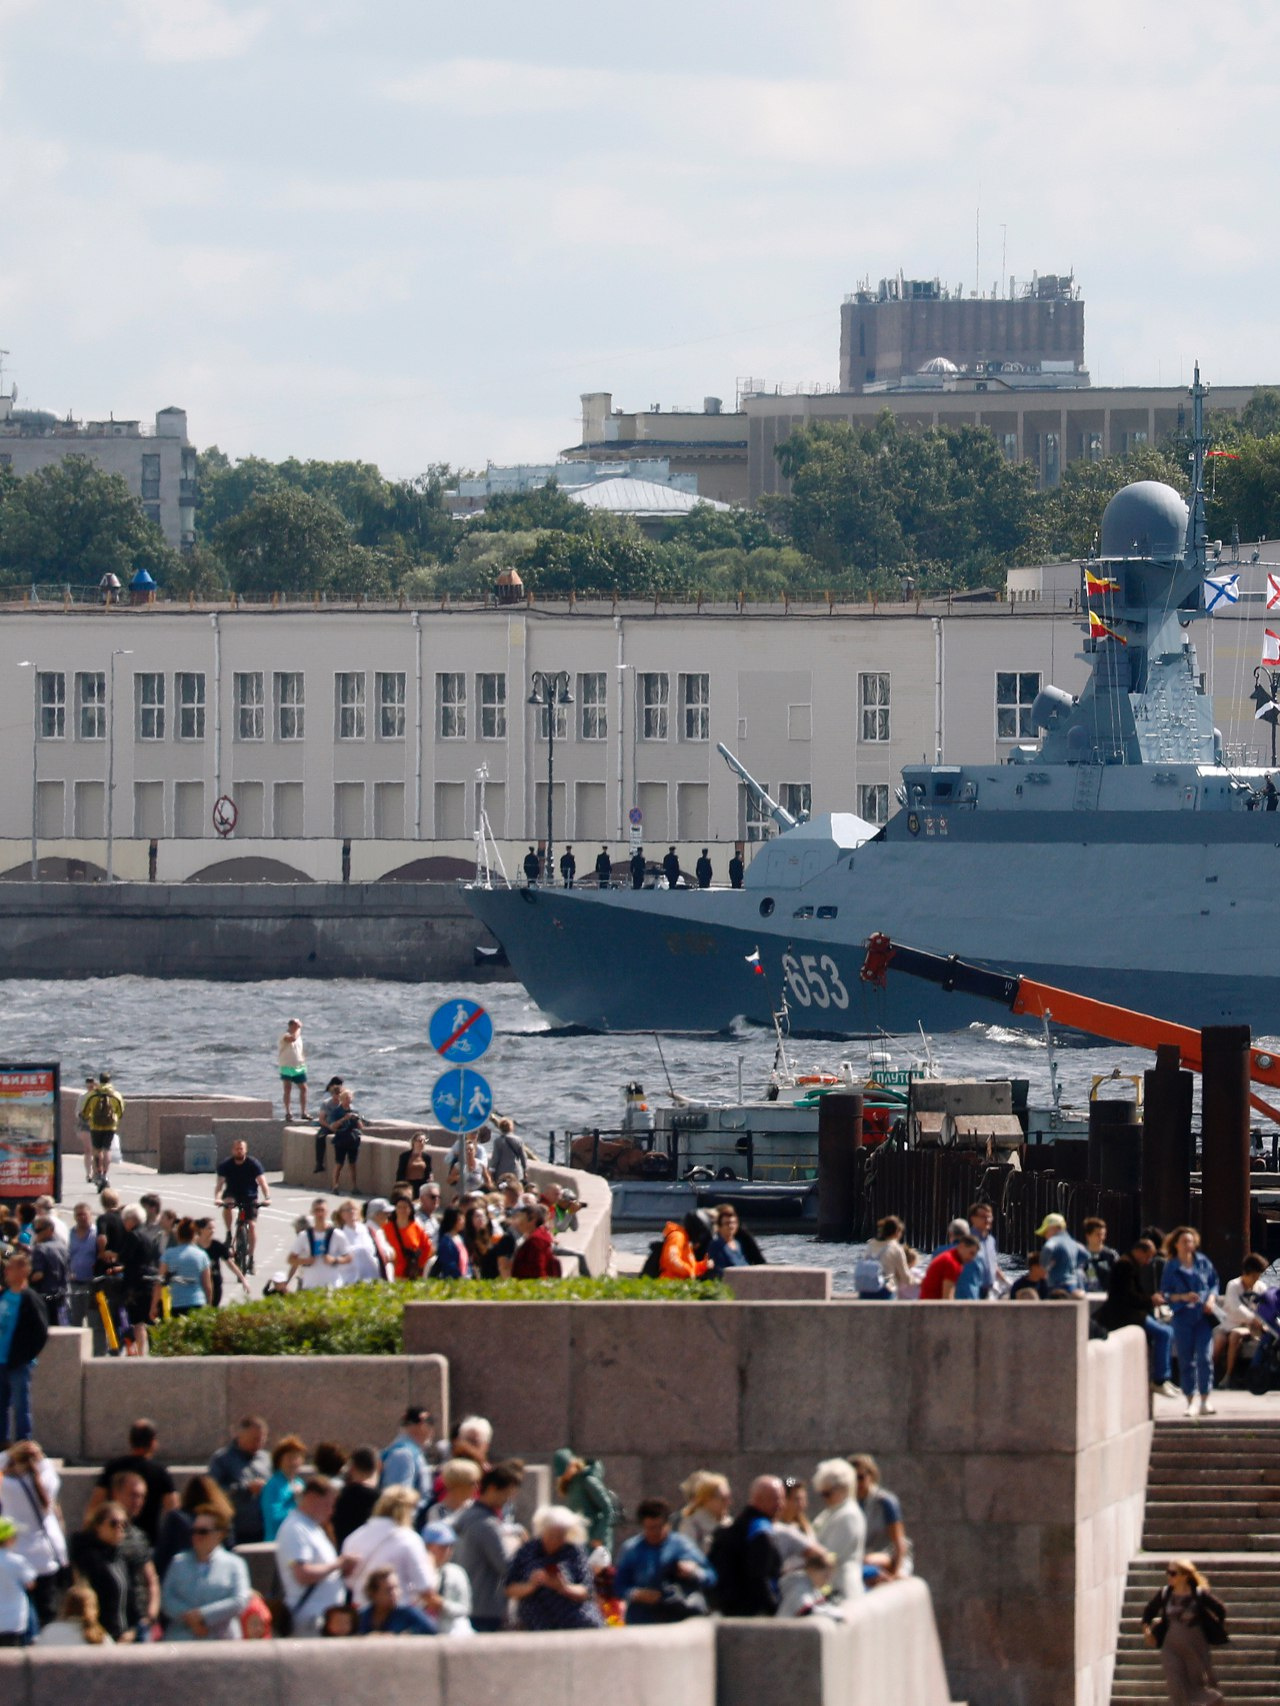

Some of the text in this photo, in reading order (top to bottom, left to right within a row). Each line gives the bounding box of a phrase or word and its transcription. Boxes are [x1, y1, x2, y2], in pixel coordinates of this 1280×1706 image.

[781, 954, 849, 1009] 653
[1004, 981, 1013, 990] 10
[0, 1074, 47, 1084] БИЛЕТ
